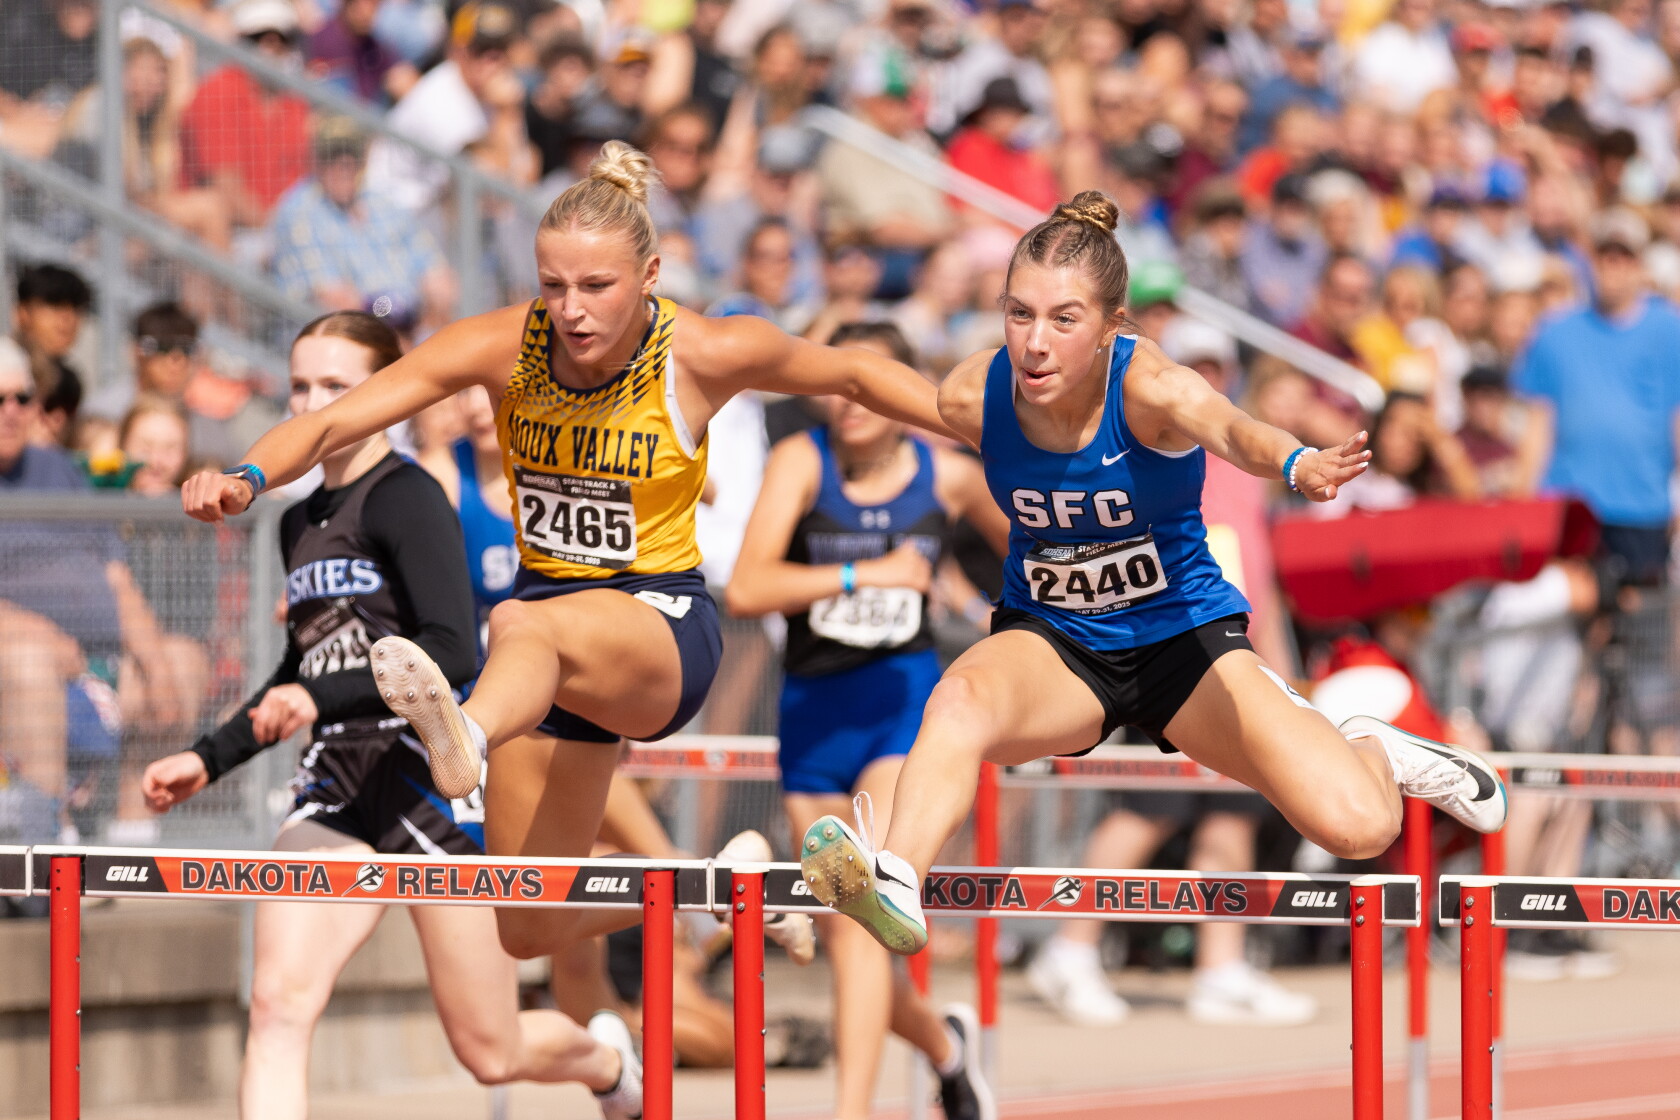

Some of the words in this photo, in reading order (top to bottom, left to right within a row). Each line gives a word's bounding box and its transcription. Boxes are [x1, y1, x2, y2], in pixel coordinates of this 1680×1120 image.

[572, 425, 659, 479] VALLEY
[584, 480, 608, 489] TRACK
[523, 494, 632, 552] 2465
[1010, 488, 1135, 529] SFC
[1031, 554, 1158, 603] 2440
[1113, 601, 1131, 610] 2025
[105, 865, 149, 882] GILL
[181, 860, 333, 894] DAKOTA
[396, 865, 544, 899] RELAYS
[584, 876, 631, 893] GILL
[922, 876, 1028, 909] KOTA
[1094, 879, 1248, 913] RELAYS
[1290, 890, 1338, 908] GILL
[1520, 894, 1567, 911] GILL
[1602, 888, 1680, 922] DAK
